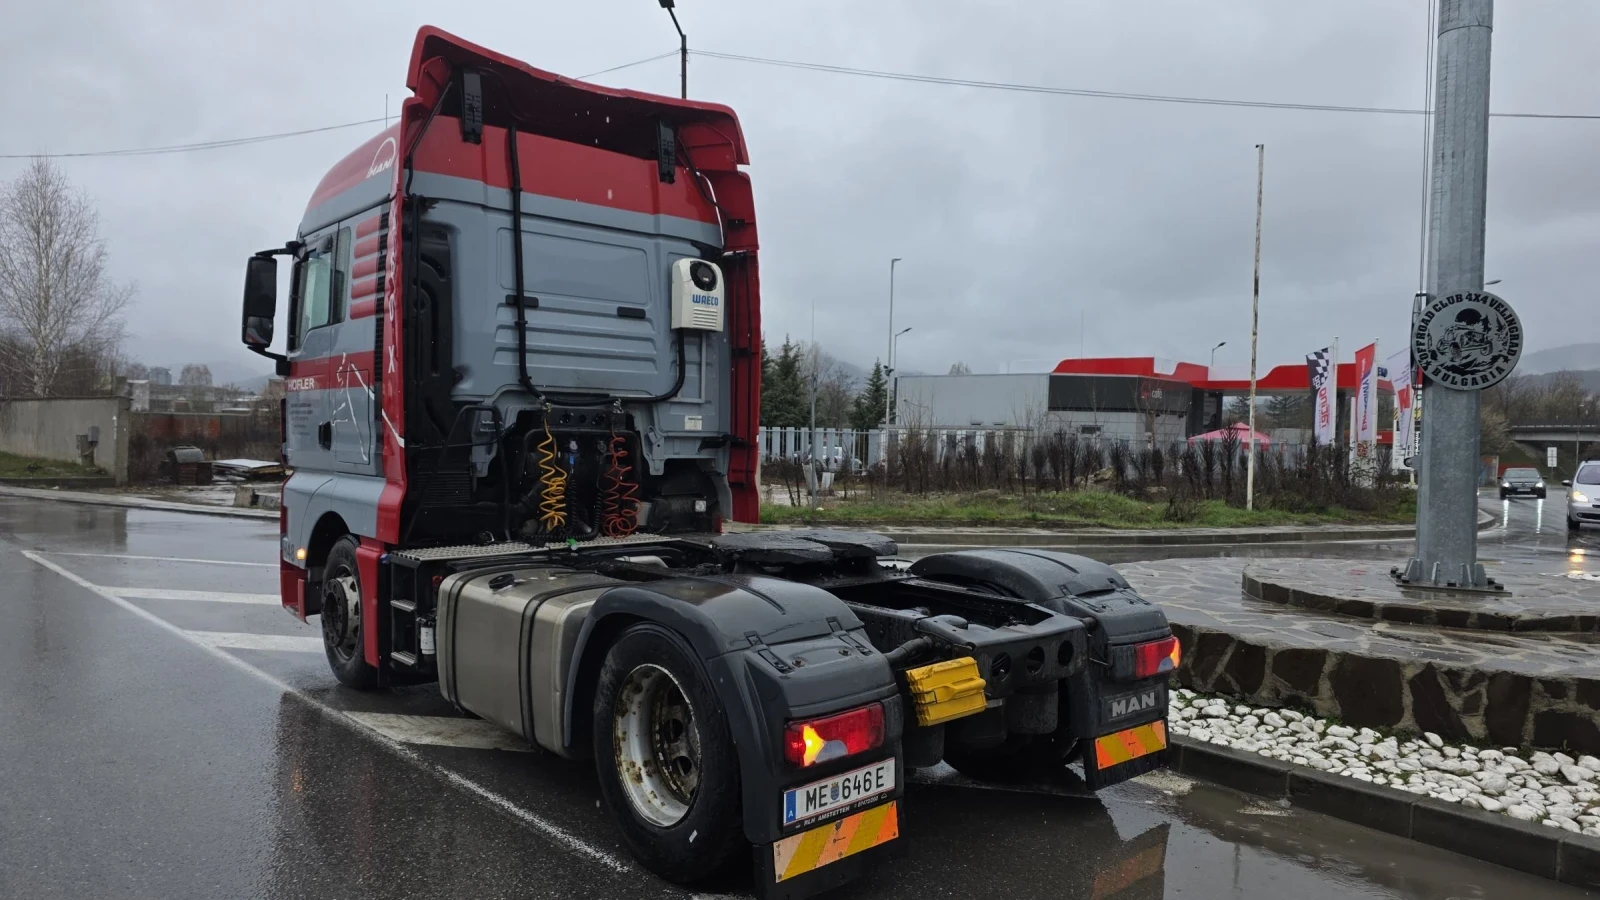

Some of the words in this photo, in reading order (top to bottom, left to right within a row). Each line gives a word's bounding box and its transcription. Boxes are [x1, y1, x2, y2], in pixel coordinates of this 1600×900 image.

[367, 157, 392, 178] MAN
[692, 294, 719, 307] WAECO
[1415, 310, 1435, 360] OFFROAD
[1432, 293, 1463, 313] CLUB
[1465, 293, 1488, 305] 4X4
[1489, 297, 1520, 357] VELINGRAD
[1431, 365, 1505, 387] BULGARIA
[1112, 692, 1155, 717] MAN
[806, 784, 828, 812] ME
[788, 809, 794, 818] A
